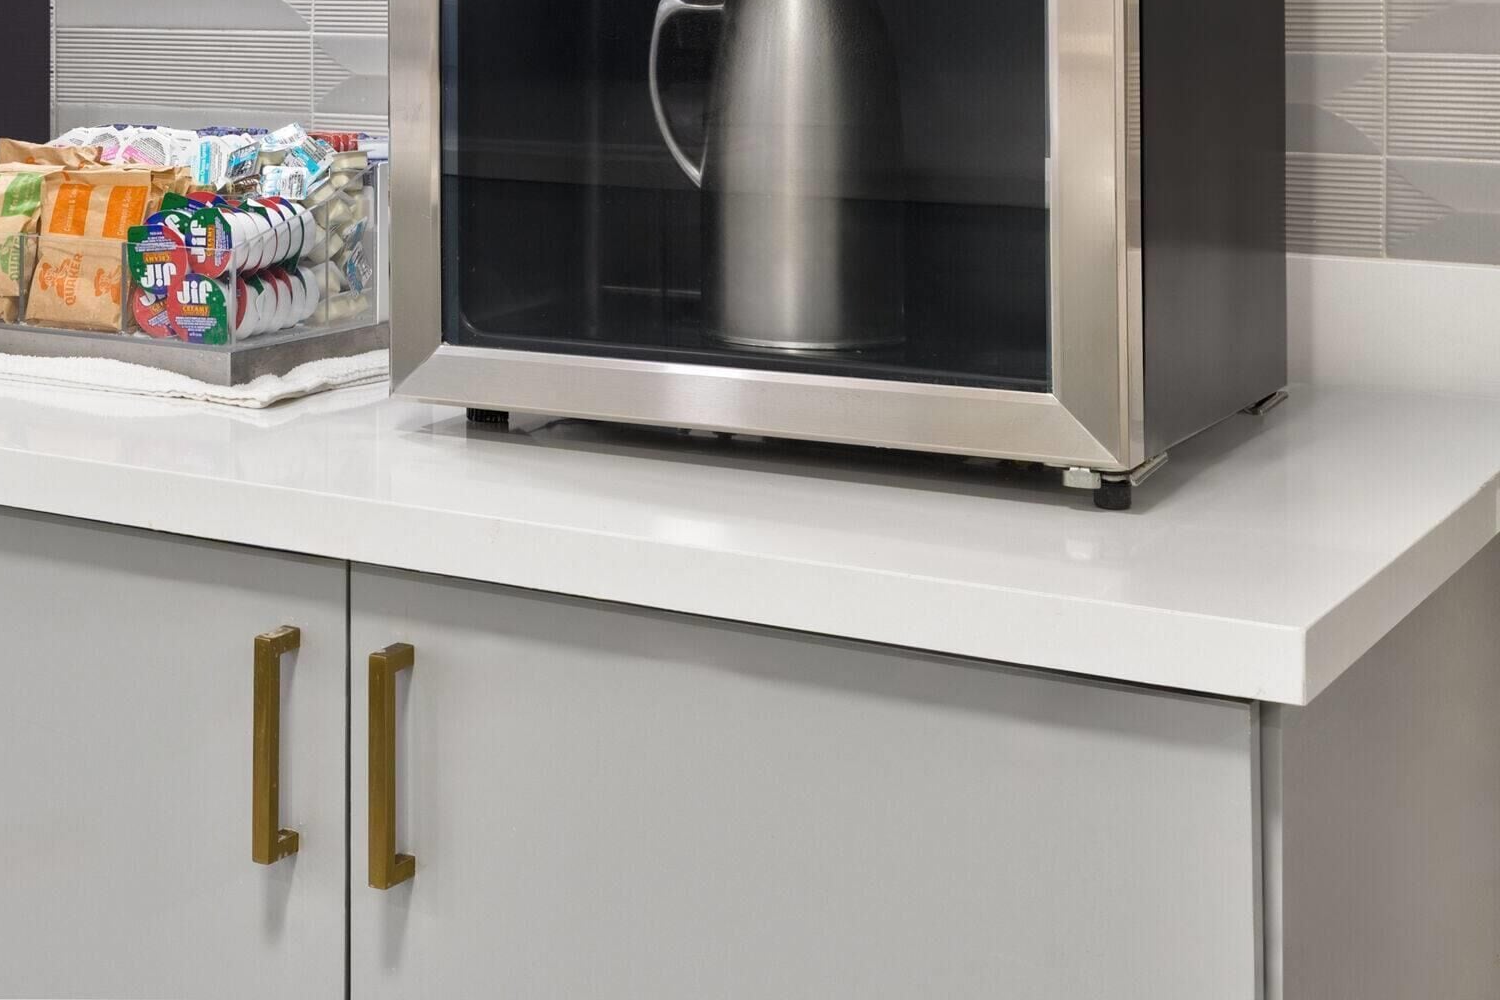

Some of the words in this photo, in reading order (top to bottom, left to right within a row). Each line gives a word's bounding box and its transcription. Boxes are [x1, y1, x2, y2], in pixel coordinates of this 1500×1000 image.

[190, 219, 206, 264] Jif
[65, 253, 83, 306] QUAKER
[140, 262, 177, 288] Jif
[176, 280, 213, 305] Jif
[182, 304, 210, 314] CREAMY
